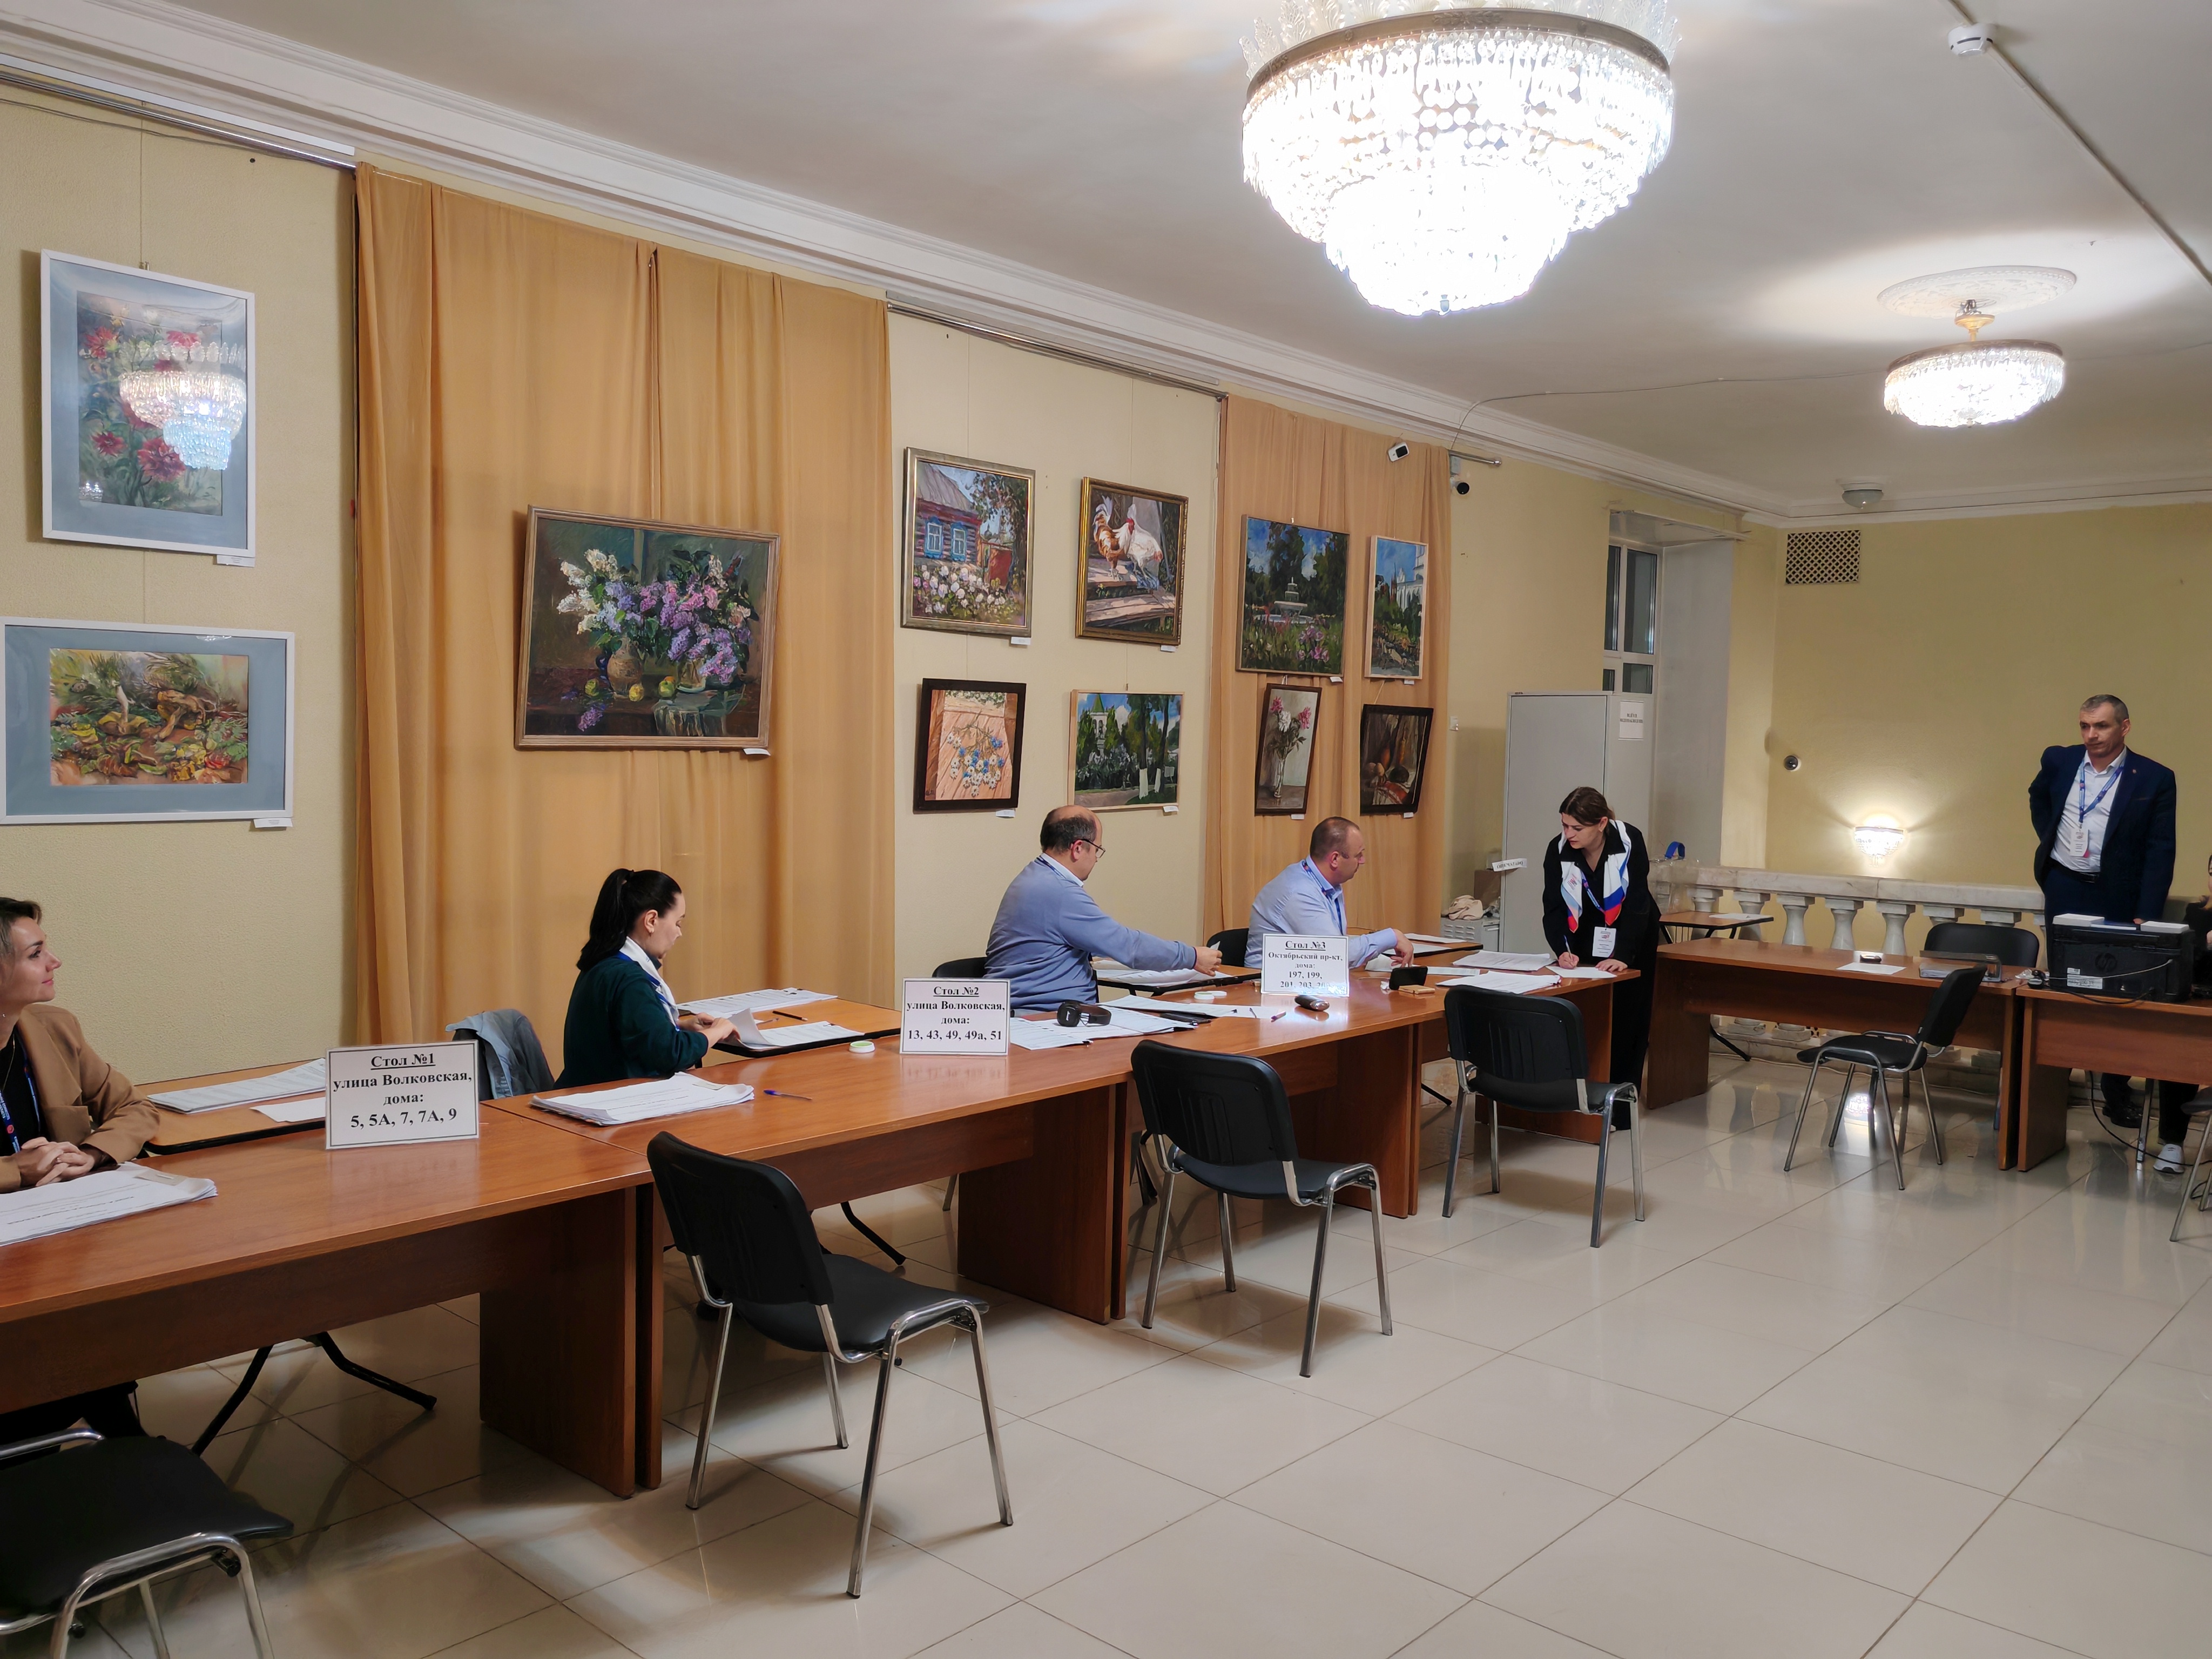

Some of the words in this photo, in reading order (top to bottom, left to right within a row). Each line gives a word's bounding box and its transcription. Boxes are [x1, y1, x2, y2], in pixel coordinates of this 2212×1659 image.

[1285, 941, 1308, 949] Стол
[1311, 941, 1326, 949] №3
[1269, 952, 1318, 960] Октябрьский
[934, 986, 959, 995] Стол
[962, 987, 979, 995] №2
[907, 1003, 938, 1011] улица
[941, 1001, 1005, 1010] Волковская,
[908, 1030, 923, 1040] 13,
[926, 1030, 942, 1040] 43,
[946, 1030, 962, 1040] 49,
[965, 1030, 987, 1041] 49а,
[990, 1030, 1001, 1040] 51
[371, 1056, 407, 1068] Стол
[412, 1053, 434, 1064] №1
[333, 1077, 377, 1092] улица
[382, 1071, 472, 1085] Волковская,
[383, 1093, 424, 1106] дома:
[350, 1115, 364, 1129] 5,
[369, 1114, 395, 1127] 5А,
[400, 1111, 414, 1125] 7,
[419, 1110, 444, 1123] 7А,
[449, 1108, 457, 1121] 9
